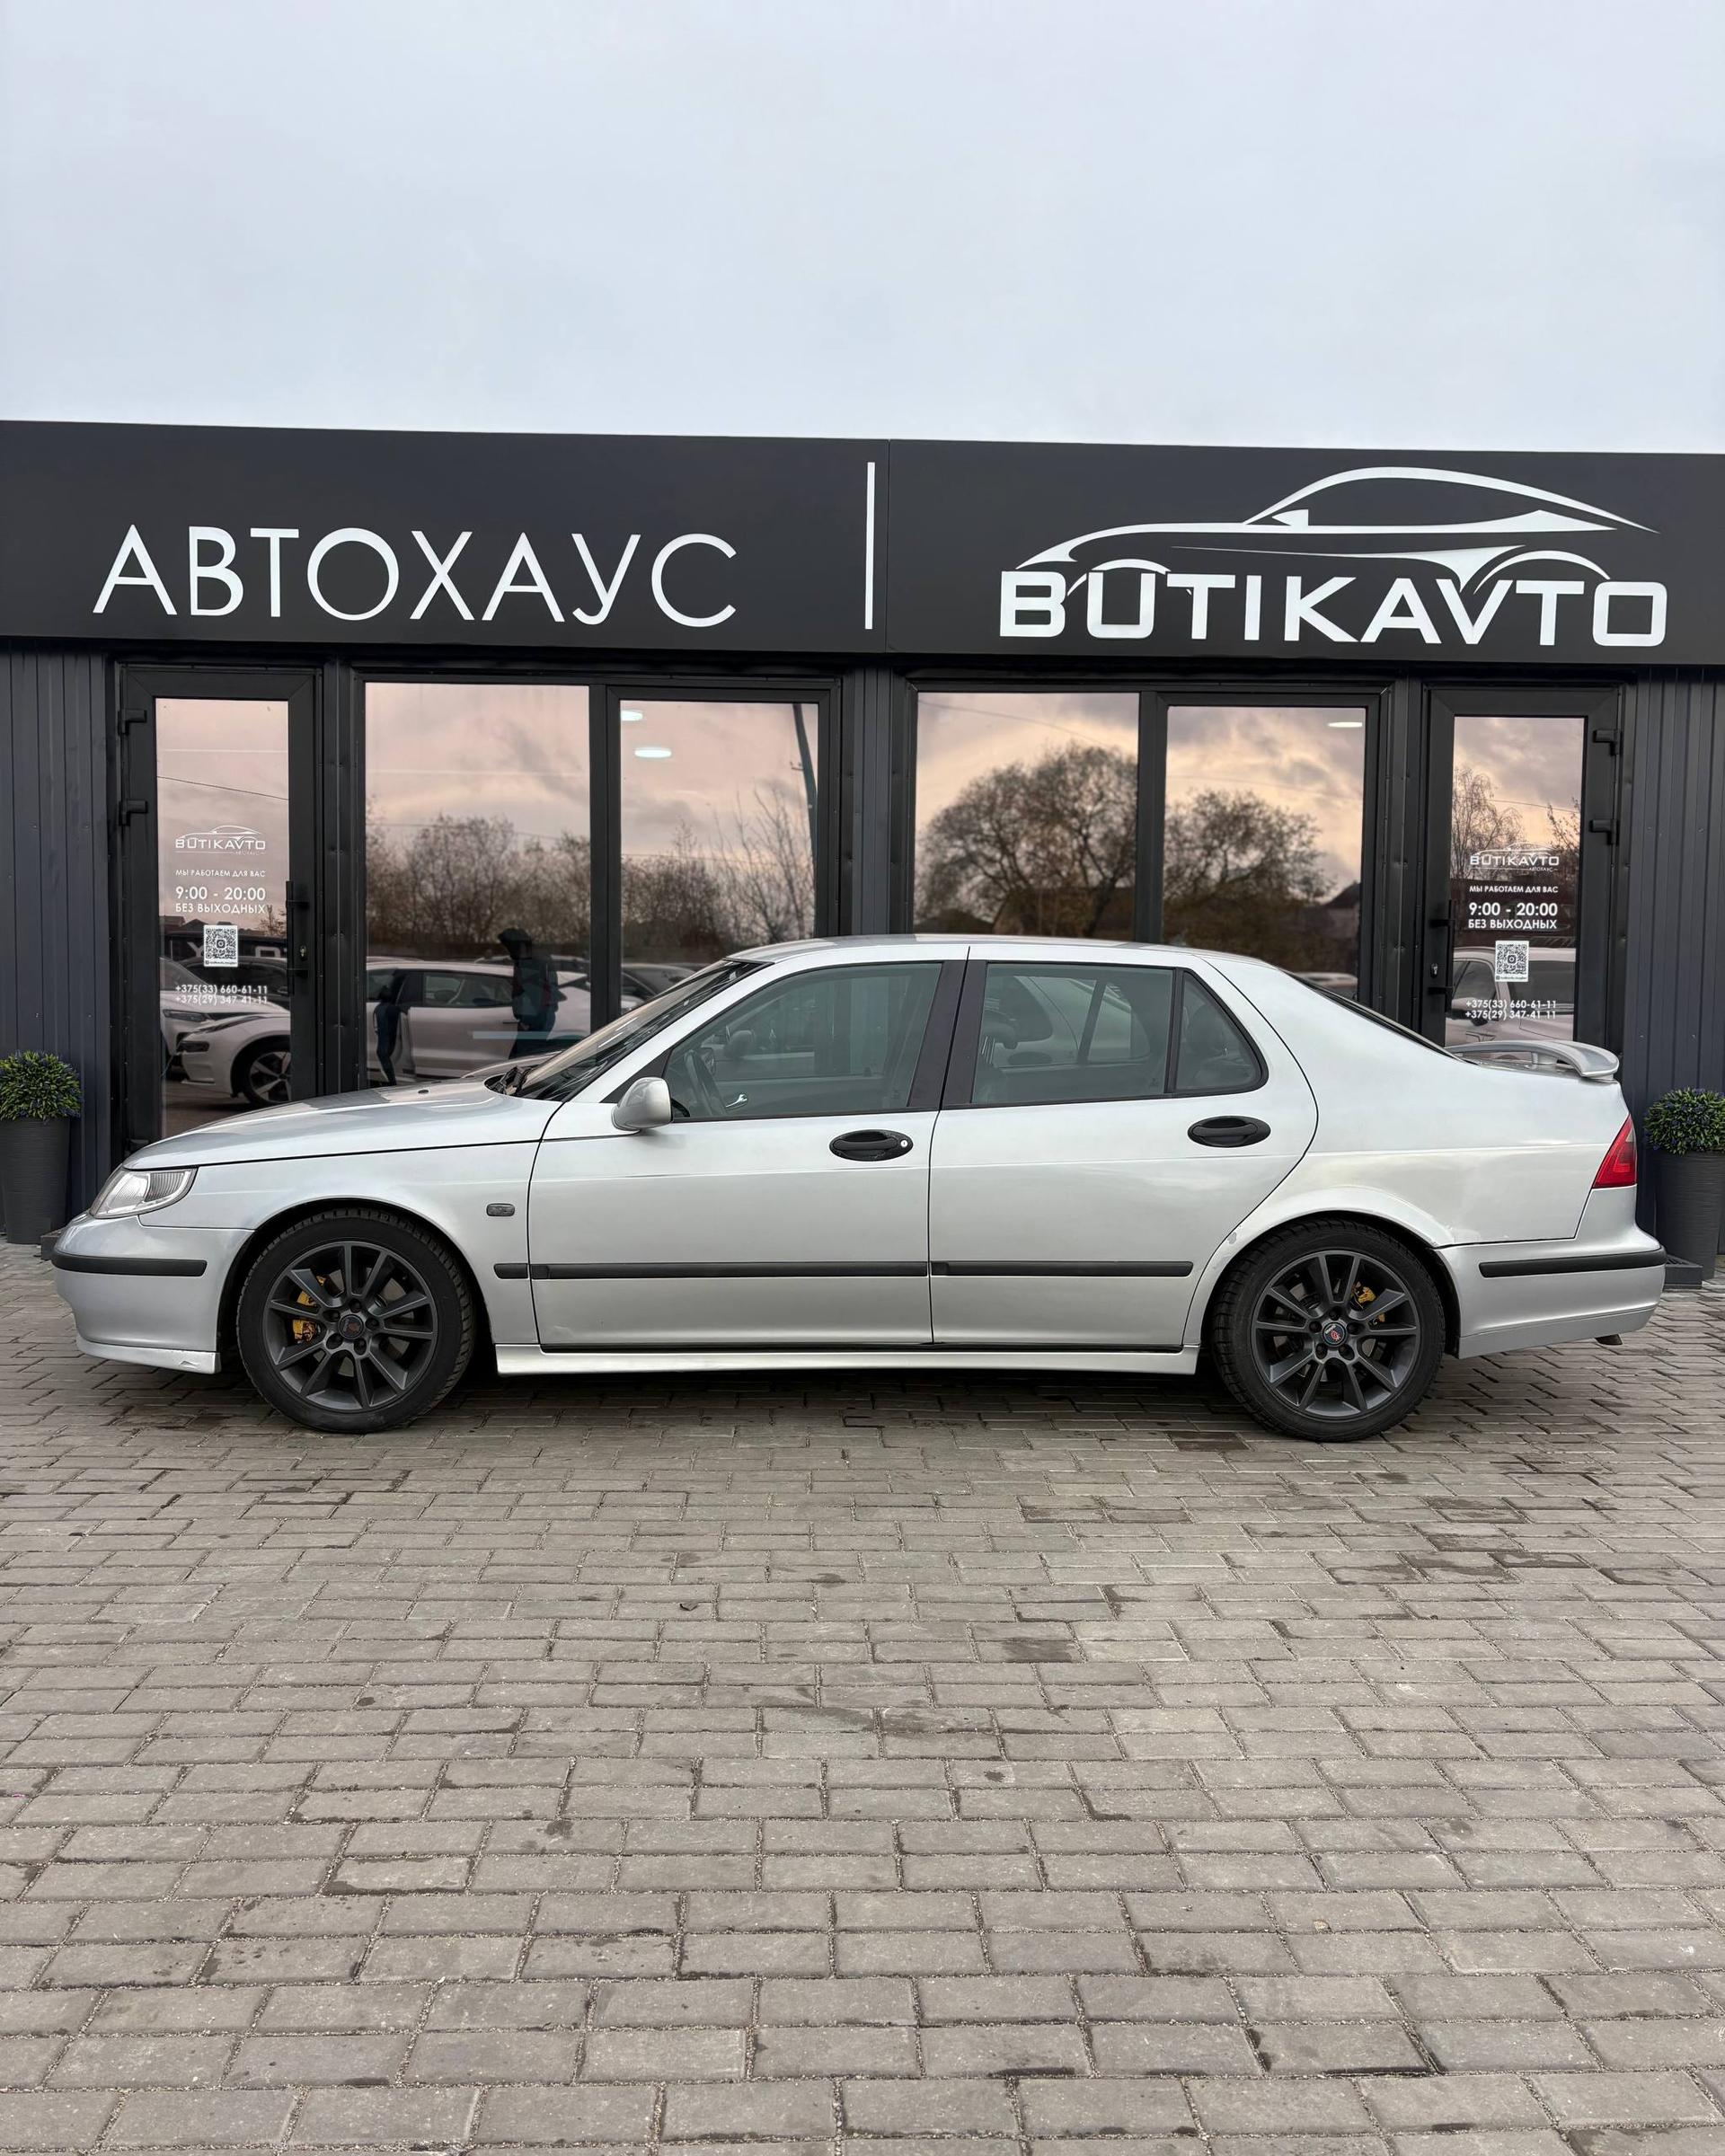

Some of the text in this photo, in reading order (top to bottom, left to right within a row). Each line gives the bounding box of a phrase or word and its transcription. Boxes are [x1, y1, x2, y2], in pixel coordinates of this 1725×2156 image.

[93, 524, 737, 628] АВТОХАУС
[999, 570, 1668, 648] BUTIKAVTO
[175, 838, 266, 850] BUTIKAVTO
[1470, 854, 1560, 866] BUTIKAVTO
[175, 886, 208, 899] 9:00
[224, 887, 266, 900] 20:00
[1525, 886, 1541, 894] ДЛЯ
[175, 903, 266, 914] БЕЗ ВЫХОДНЫХ
[1469, 902, 1500, 915] 9:00
[1517, 902, 1558, 916] 20:00
[1468, 919, 1557, 930] БЕЗ ВЫХОДНЫХ
[175, 985, 268, 994] +375(33) 660-61-11
[220, 995, 268, 1004] 34741-11
[1465, 1000, 1556, 1010] +375(33) 660-61-11
[1465, 1011, 1556, 1021] +375(29) 347-4111
